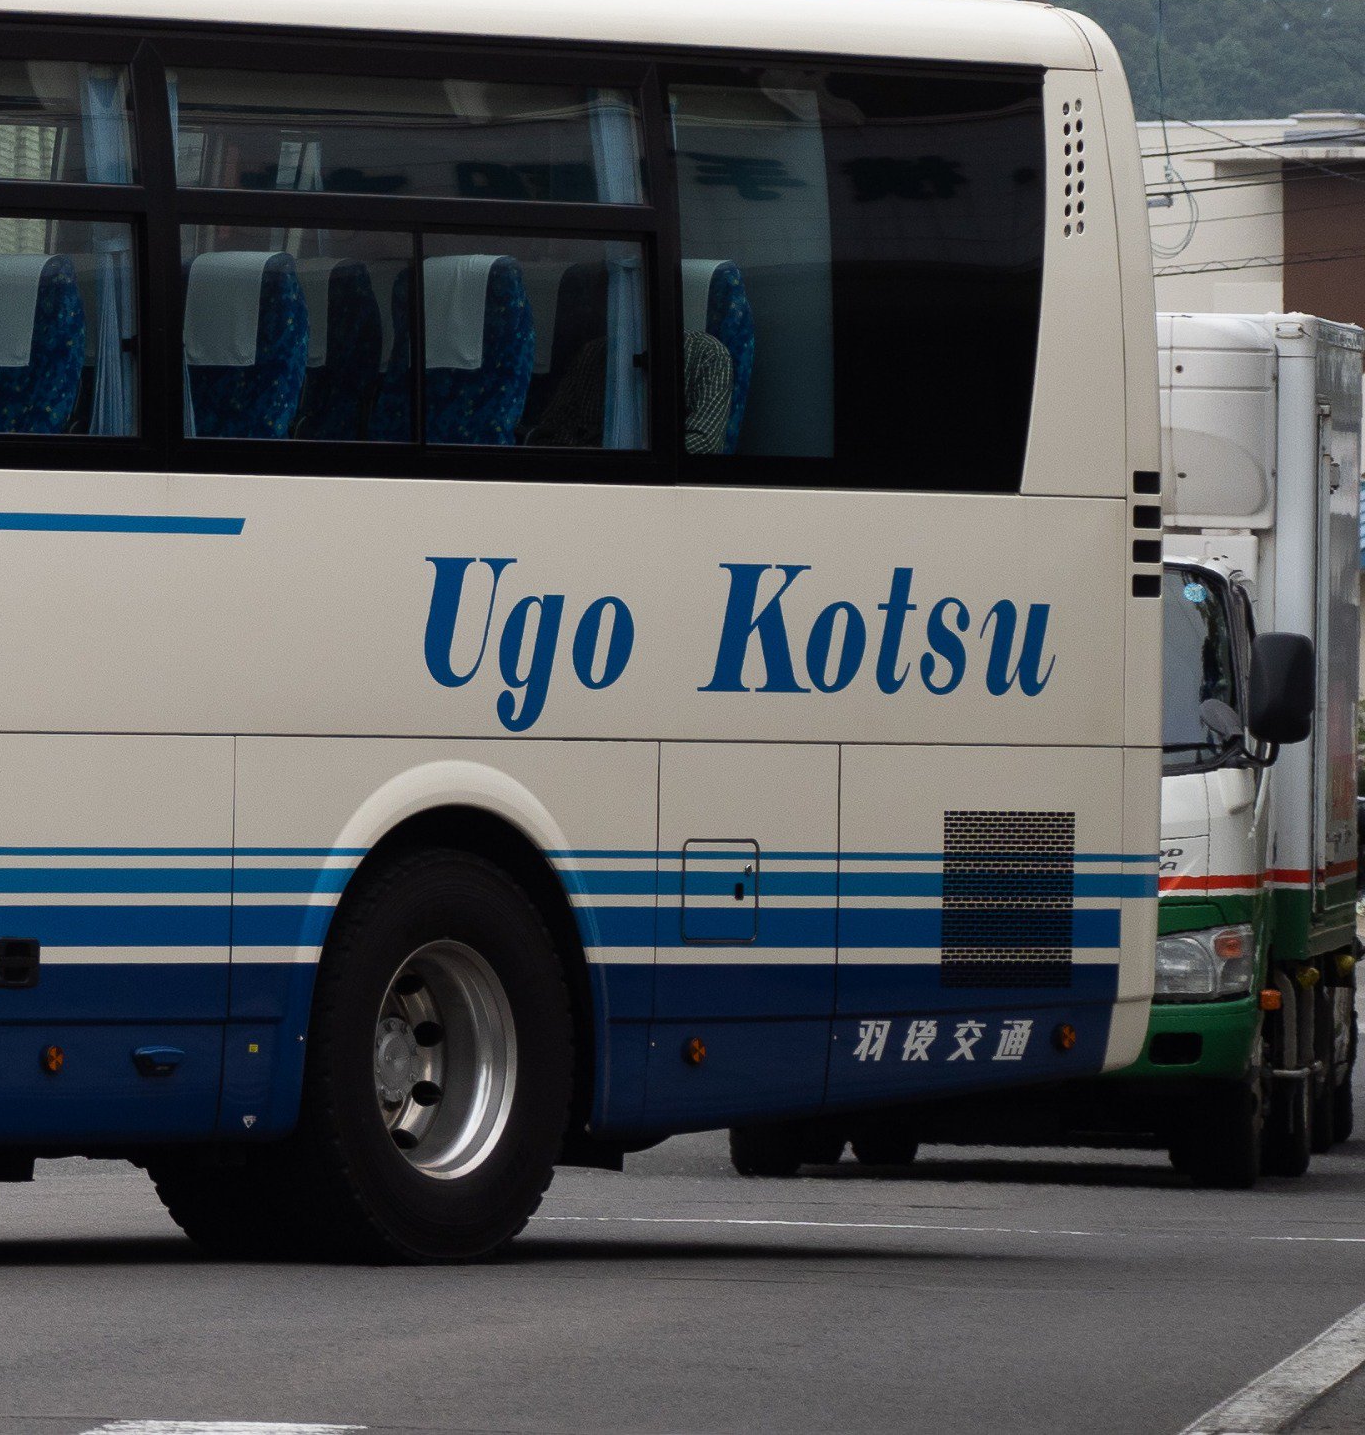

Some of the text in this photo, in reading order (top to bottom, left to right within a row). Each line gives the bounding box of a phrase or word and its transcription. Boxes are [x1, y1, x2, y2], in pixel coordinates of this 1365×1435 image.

[424, 556, 1056, 732] Ugo Kotsu
[852, 1019, 1034, 1062] 羽後交通
